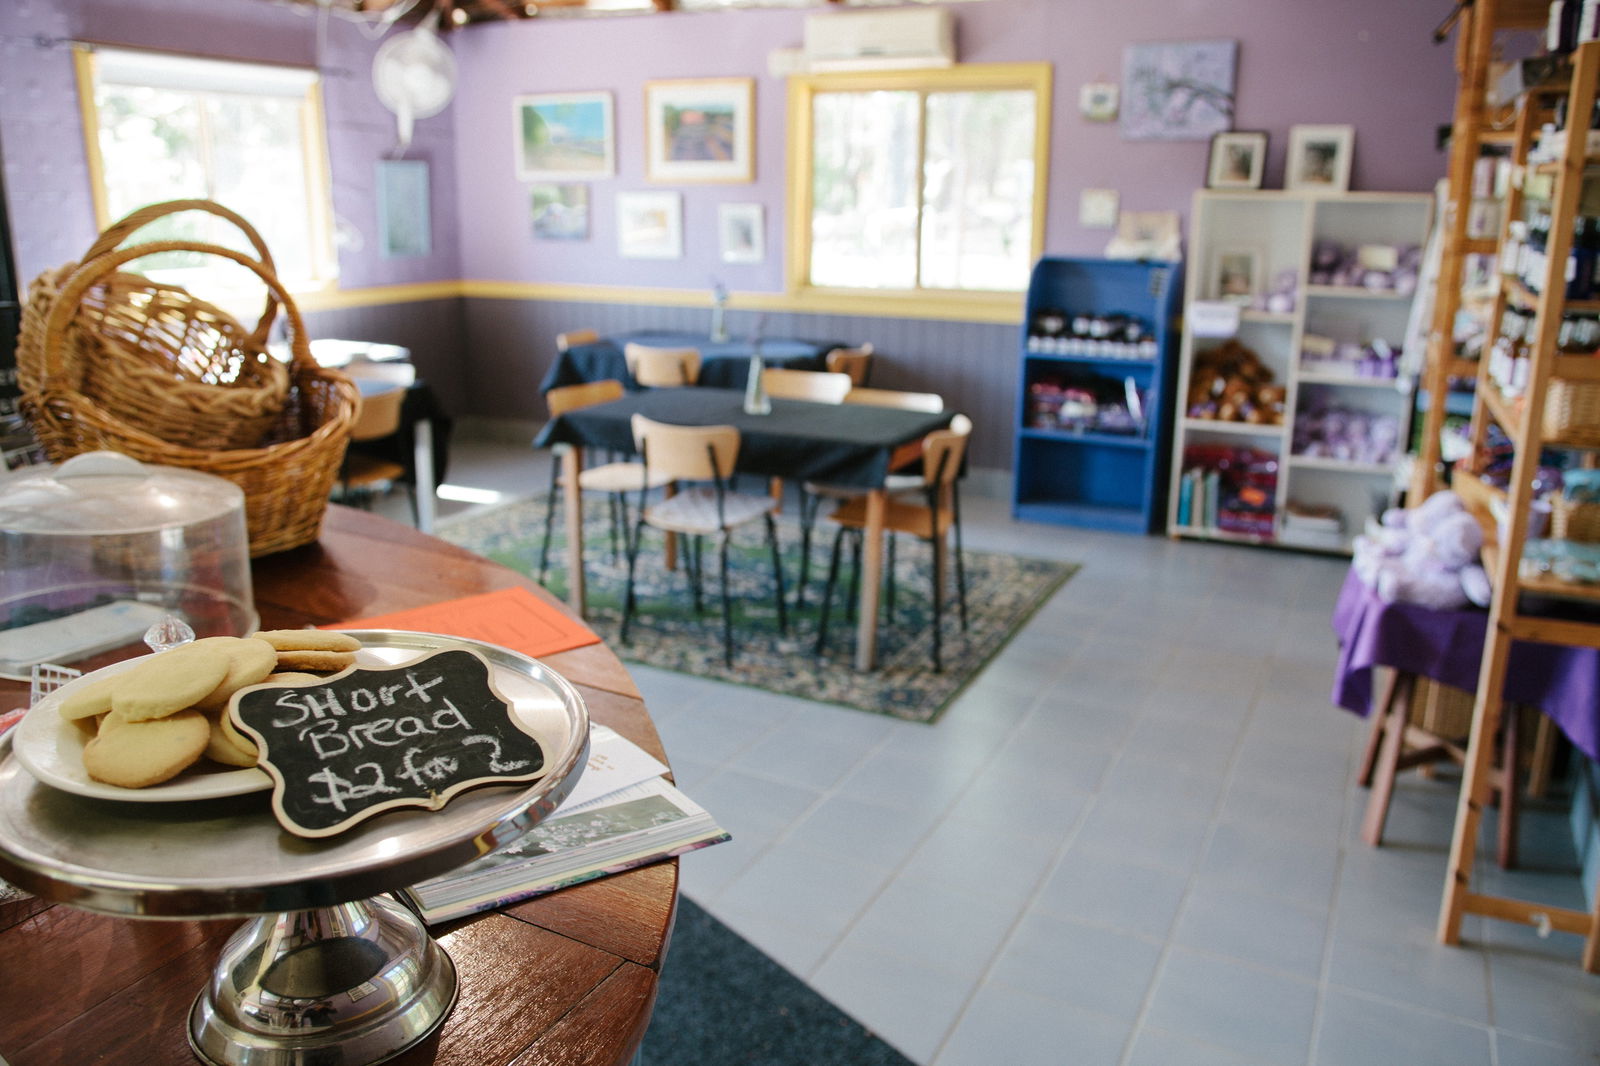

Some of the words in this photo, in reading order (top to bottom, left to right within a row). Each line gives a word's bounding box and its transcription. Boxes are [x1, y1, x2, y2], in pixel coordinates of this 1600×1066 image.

[272, 671, 444, 728] SHort
[299, 696, 473, 760] Bread
[307, 762, 402, 813] $2
[462, 735, 531, 774] 2
